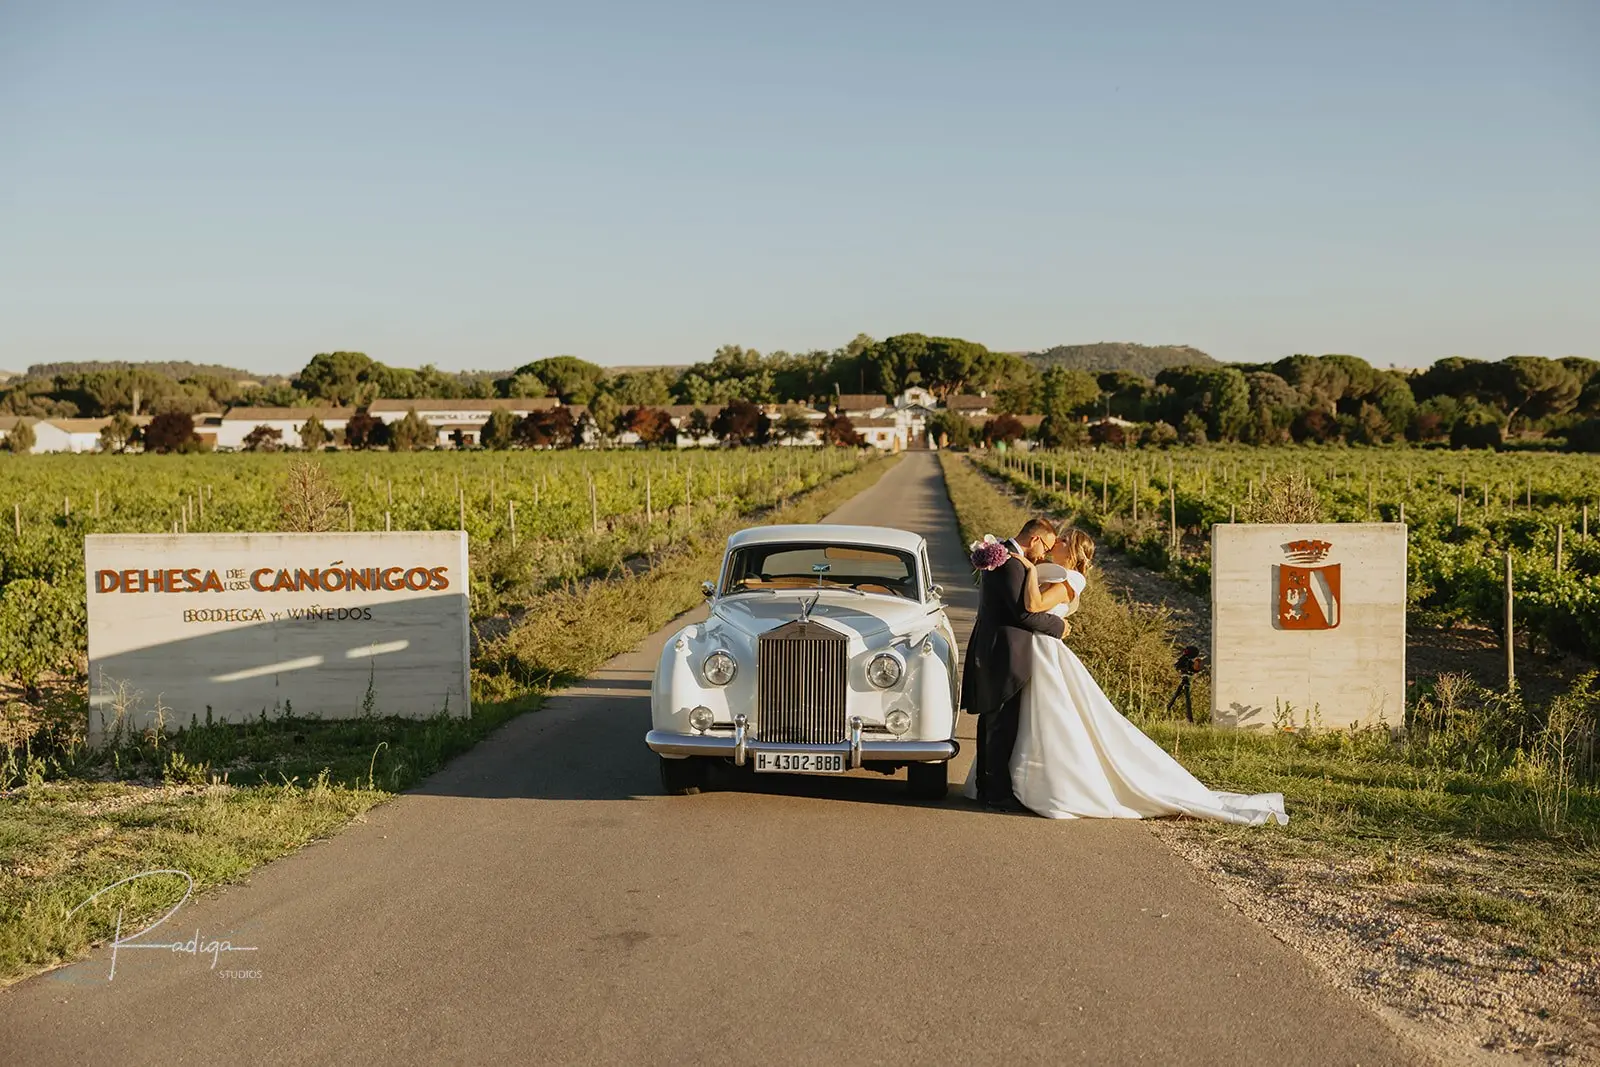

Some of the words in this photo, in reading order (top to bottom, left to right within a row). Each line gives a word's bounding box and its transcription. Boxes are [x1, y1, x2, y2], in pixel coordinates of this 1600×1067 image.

[96, 568, 225, 593] DEHESA
[226, 569, 246, 579] DE
[251, 560, 450, 593] CANÓNIGOS
[224, 581, 250, 591] LOS
[183, 608, 266, 622] BODEGA
[287, 603, 373, 621] VIÑEDOS
[758, 753, 841, 771] H-4302-BBB
